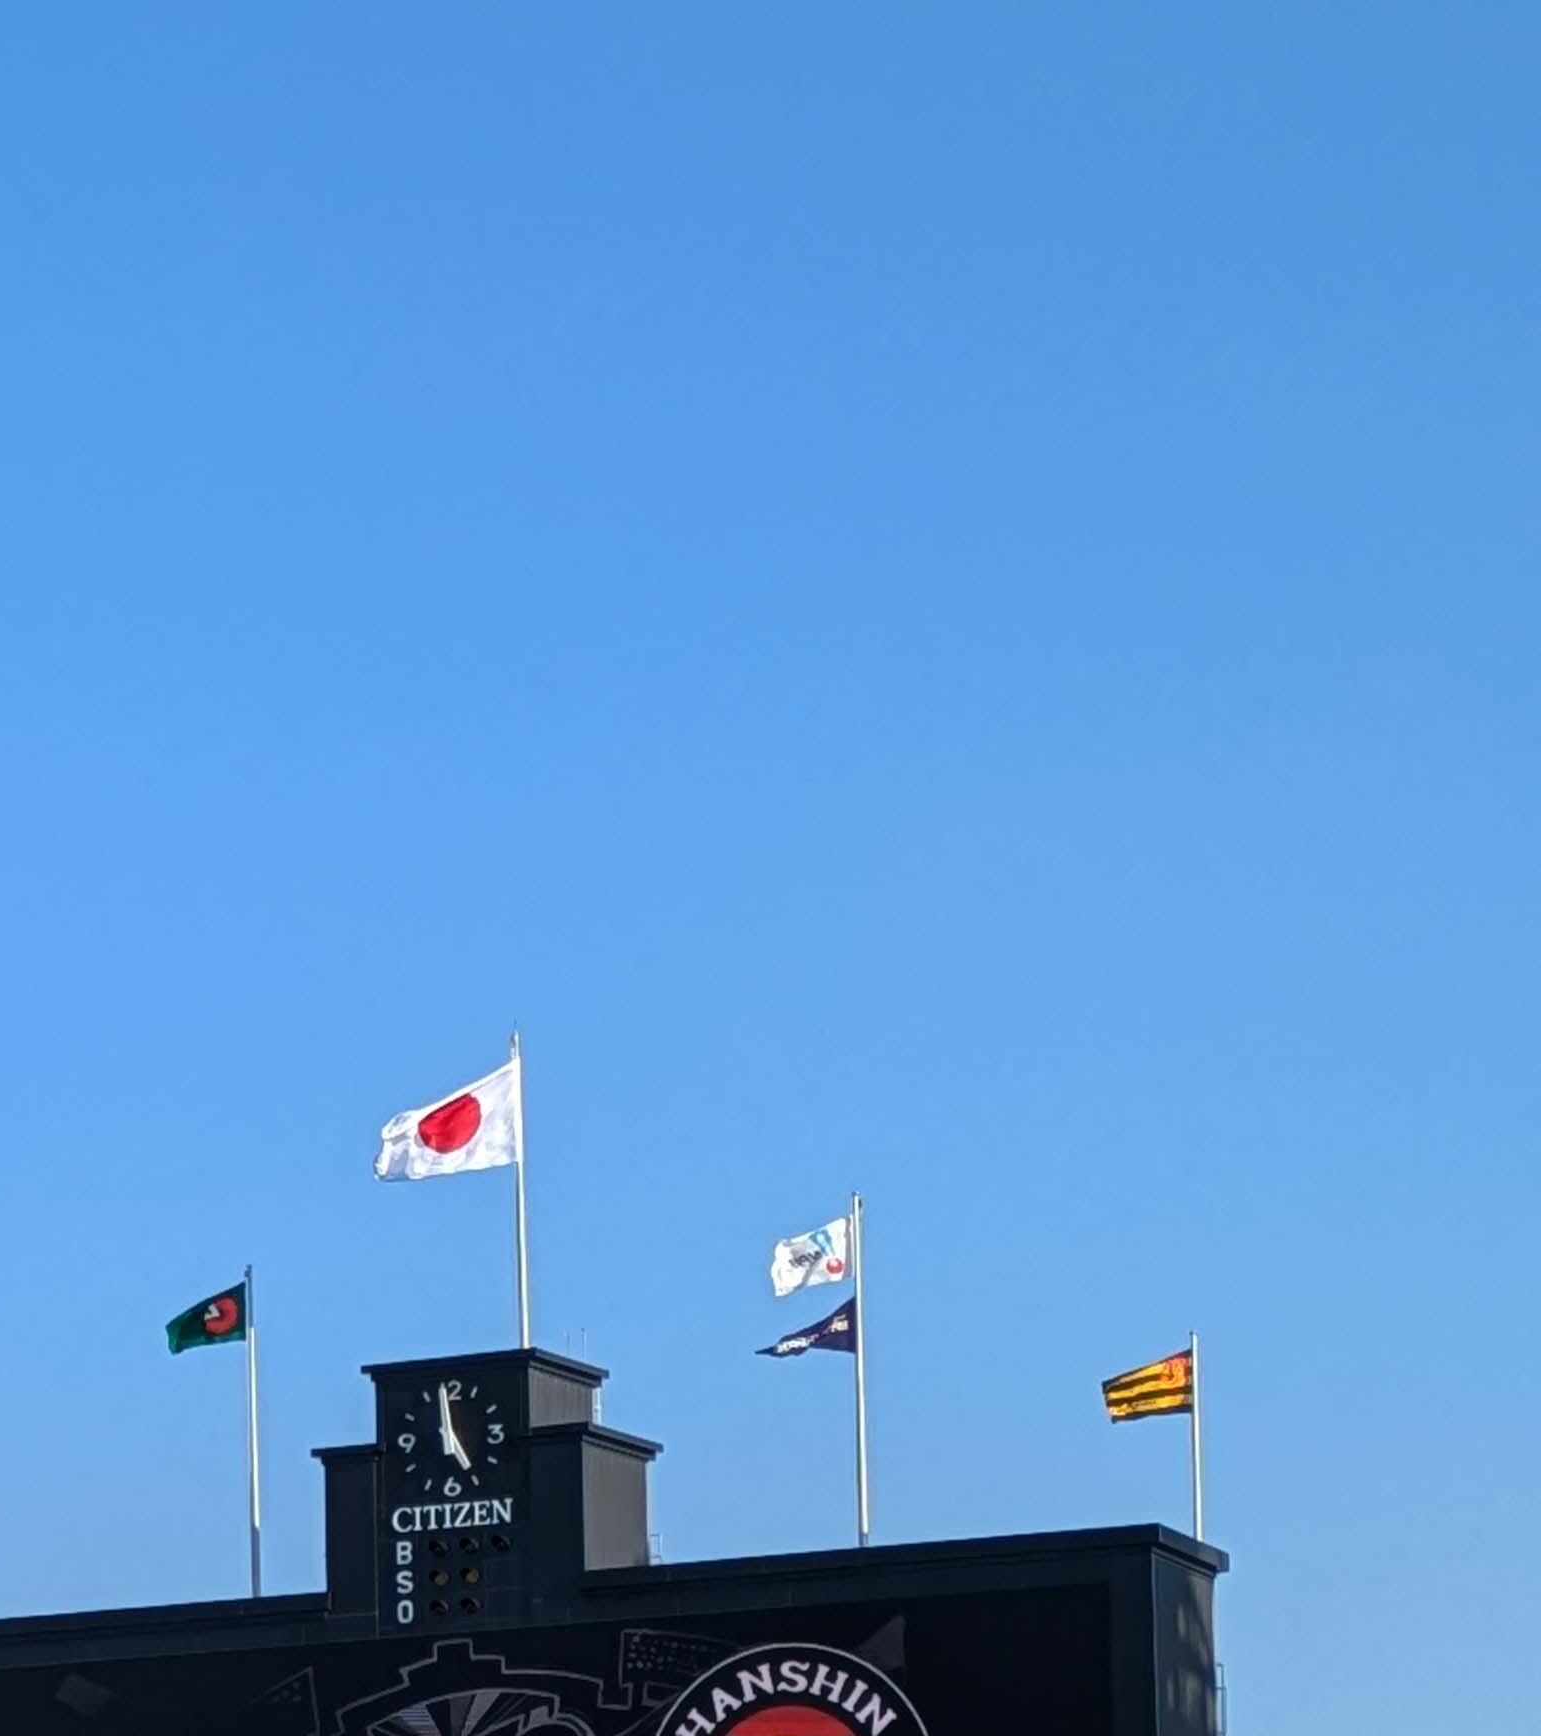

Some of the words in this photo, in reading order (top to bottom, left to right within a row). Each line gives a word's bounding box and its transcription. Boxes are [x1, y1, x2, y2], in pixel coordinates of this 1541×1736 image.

[439, 1380, 462, 1401] 2
[397, 1433, 415, 1453] 9
[487, 1423, 505, 1445] 3
[443, 1476, 462, 1497] 6
[391, 1498, 514, 1533] CITIZEN
[396, 1541, 413, 1566] B
[396, 1570, 414, 1594] S
